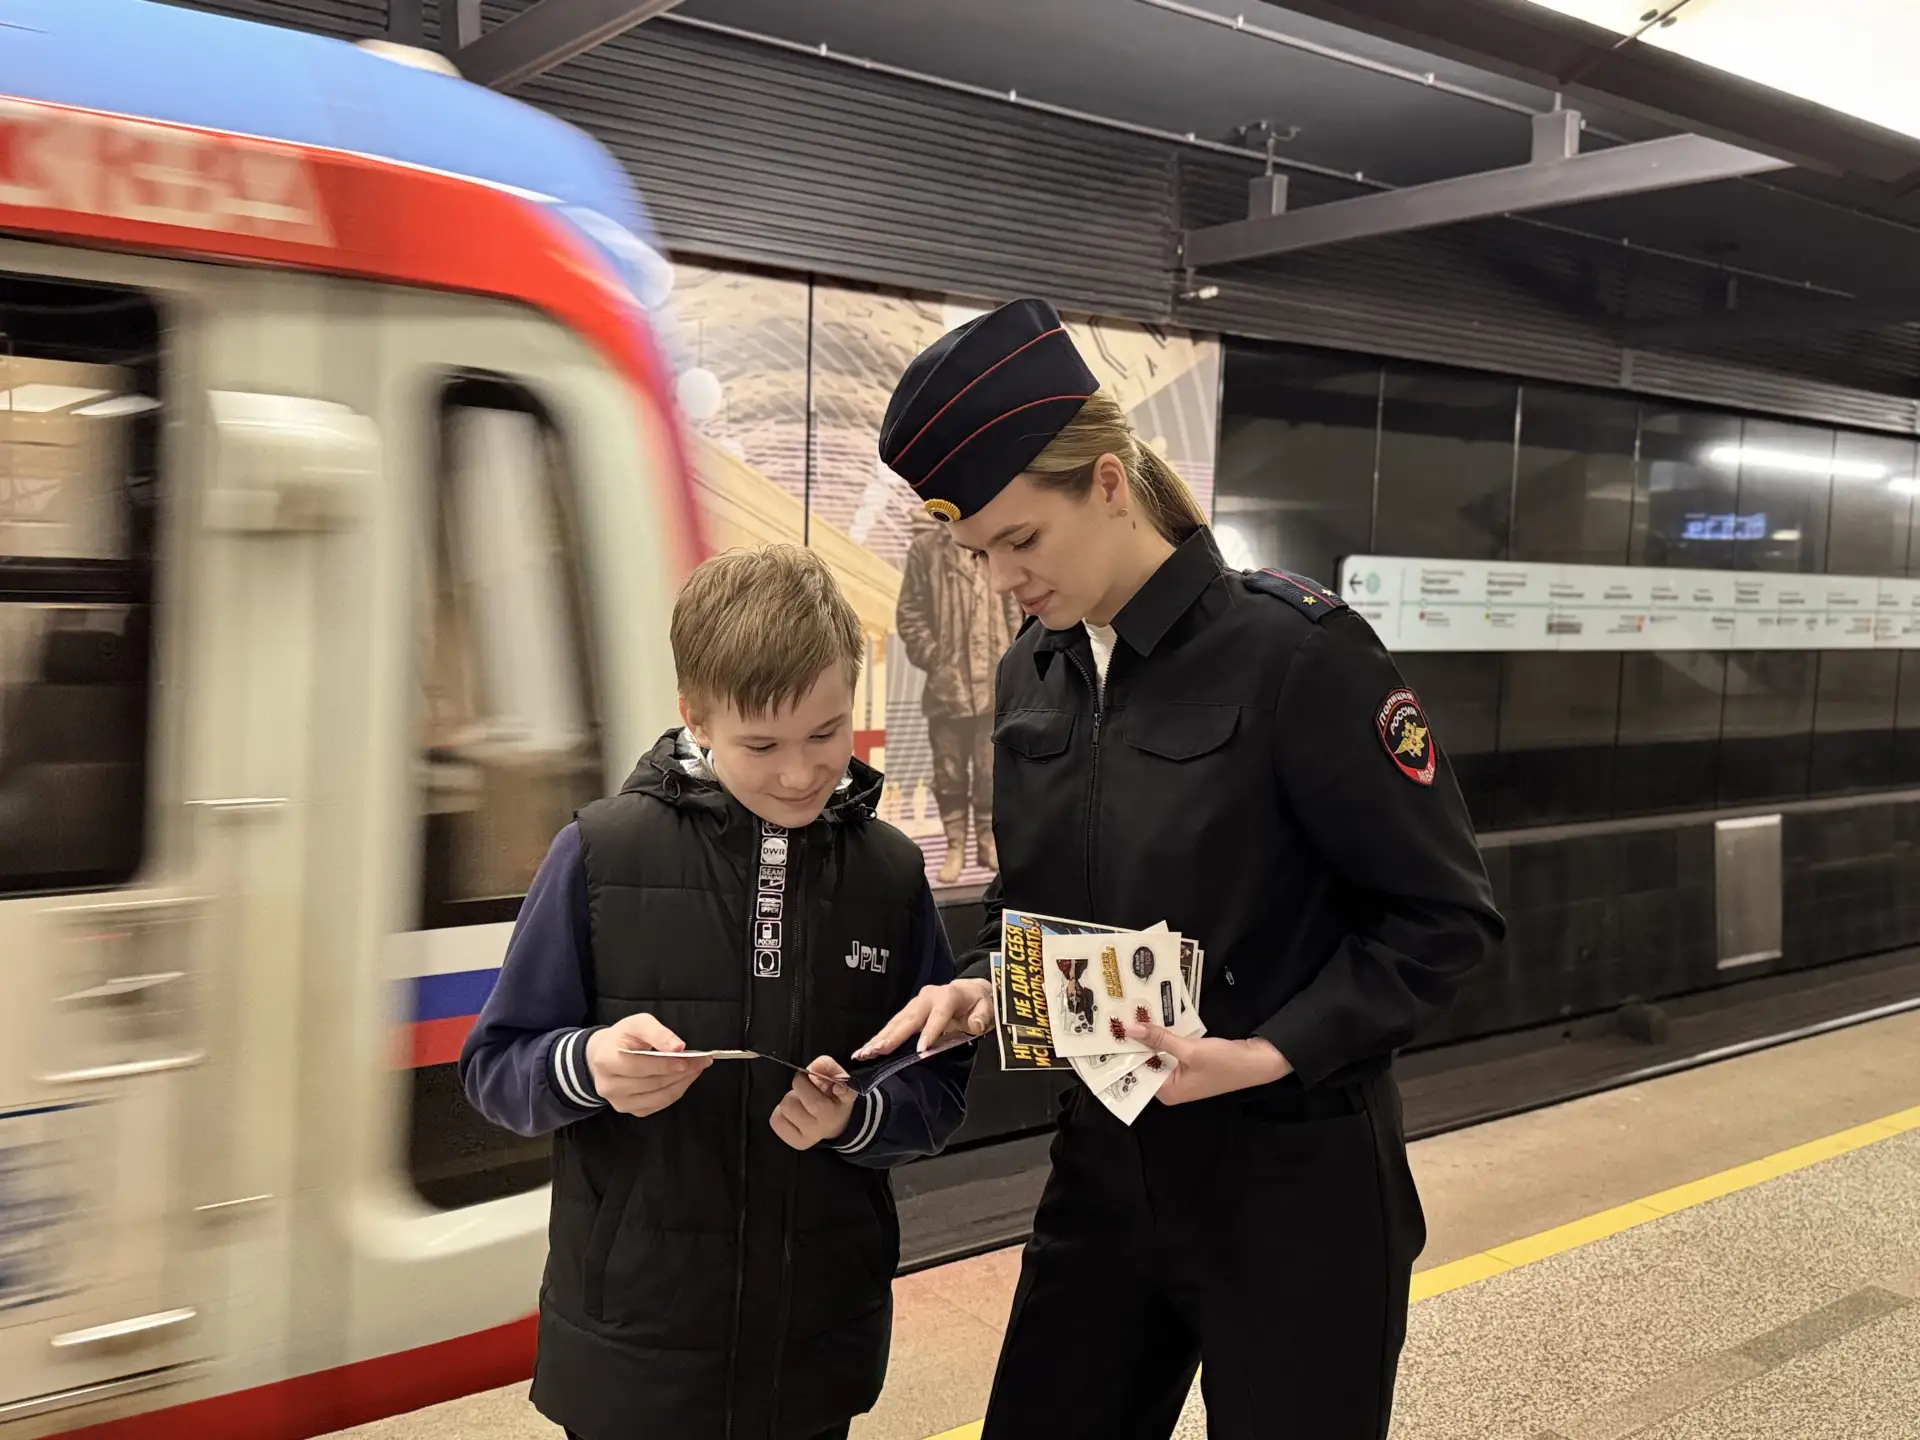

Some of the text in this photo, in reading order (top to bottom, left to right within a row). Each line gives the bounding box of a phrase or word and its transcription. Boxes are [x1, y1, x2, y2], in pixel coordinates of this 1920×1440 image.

[1378, 691, 1414, 727] ПОЛИЦИЯ
[1390, 706, 1417, 736] РОССИЯ
[1417, 762, 1435, 782] МВД
[763, 847, 785, 856] DWR
[762, 867, 784, 876] SEAM
[758, 938, 779, 946] POCKET
[845, 940, 890, 974] JPLT
[1006, 923, 1033, 1019] НЕ ДАЙ СЕБЯ
[1020, 915, 1050, 1028] ИСПОЛЬЗОВАТЬ!
